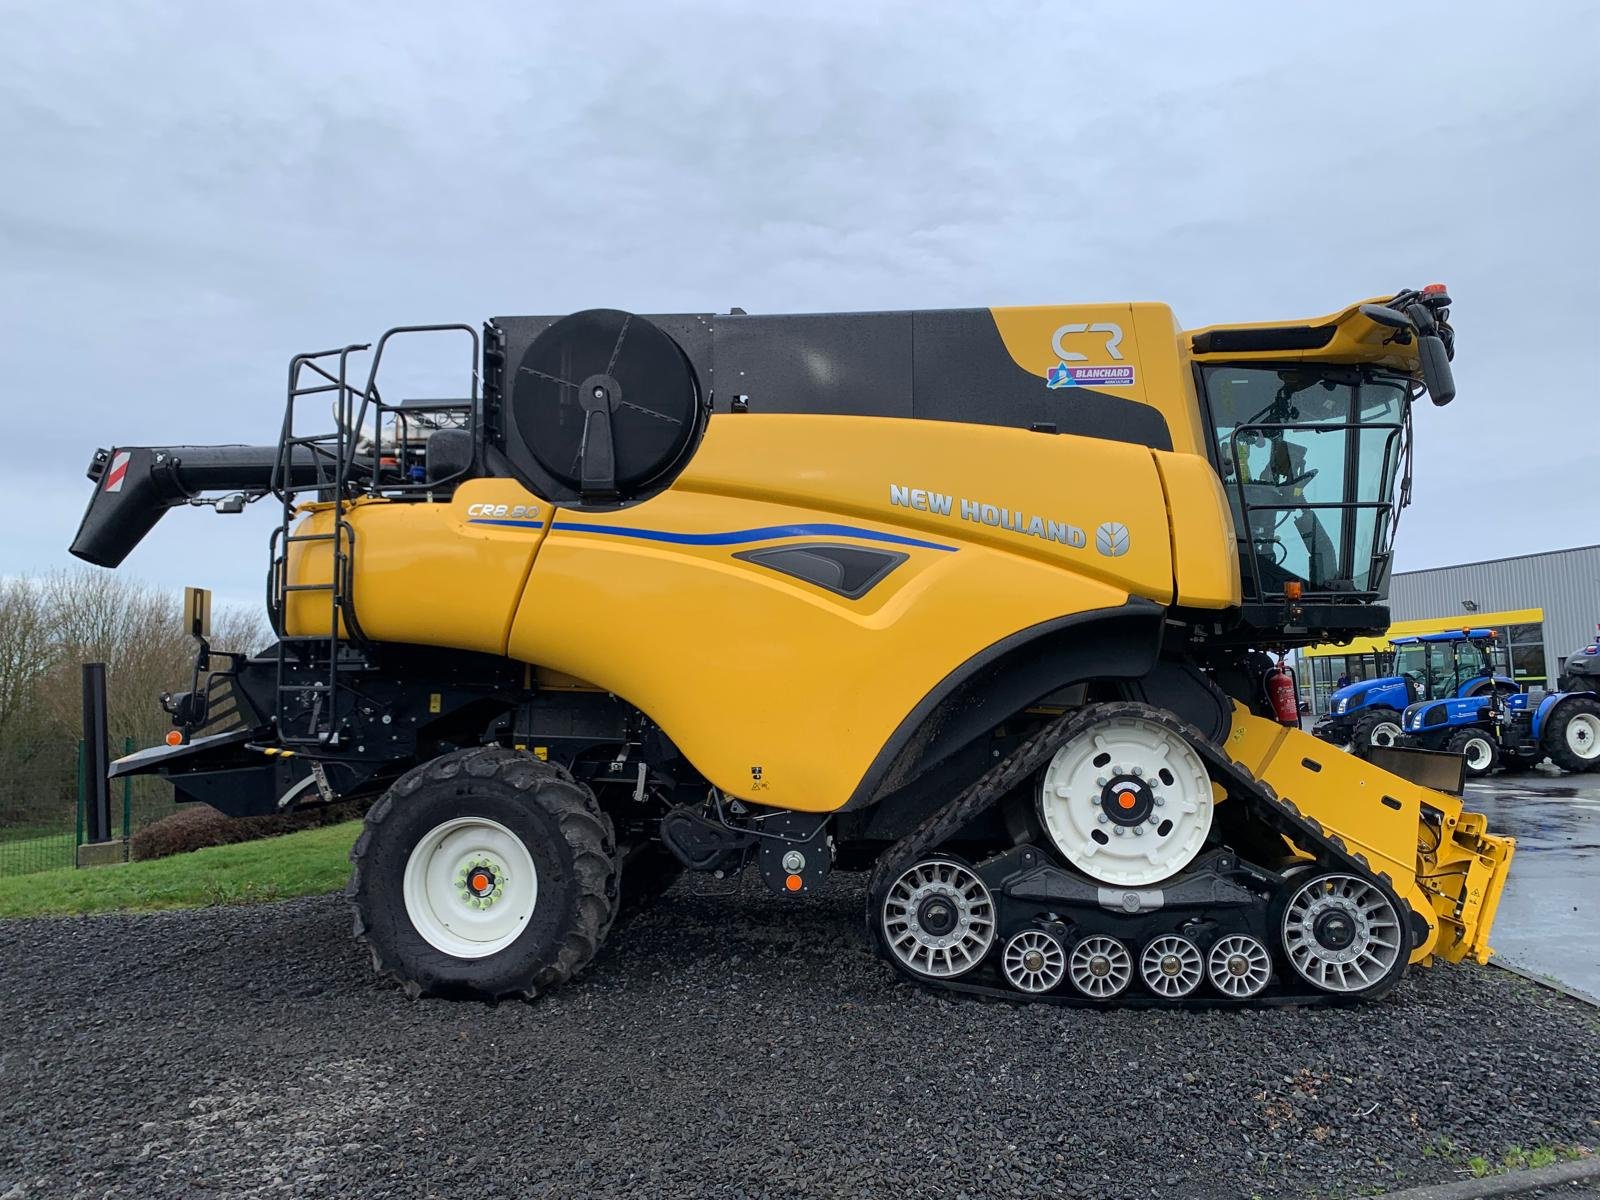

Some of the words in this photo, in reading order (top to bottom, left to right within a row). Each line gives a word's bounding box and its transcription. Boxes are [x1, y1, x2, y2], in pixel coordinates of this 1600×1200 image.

[1051, 323, 1124, 361] CR
[1075, 368, 1130, 378] BLANCHARD
[889, 484, 954, 516] NEW
[960, 498, 1087, 549] HOLLAND
